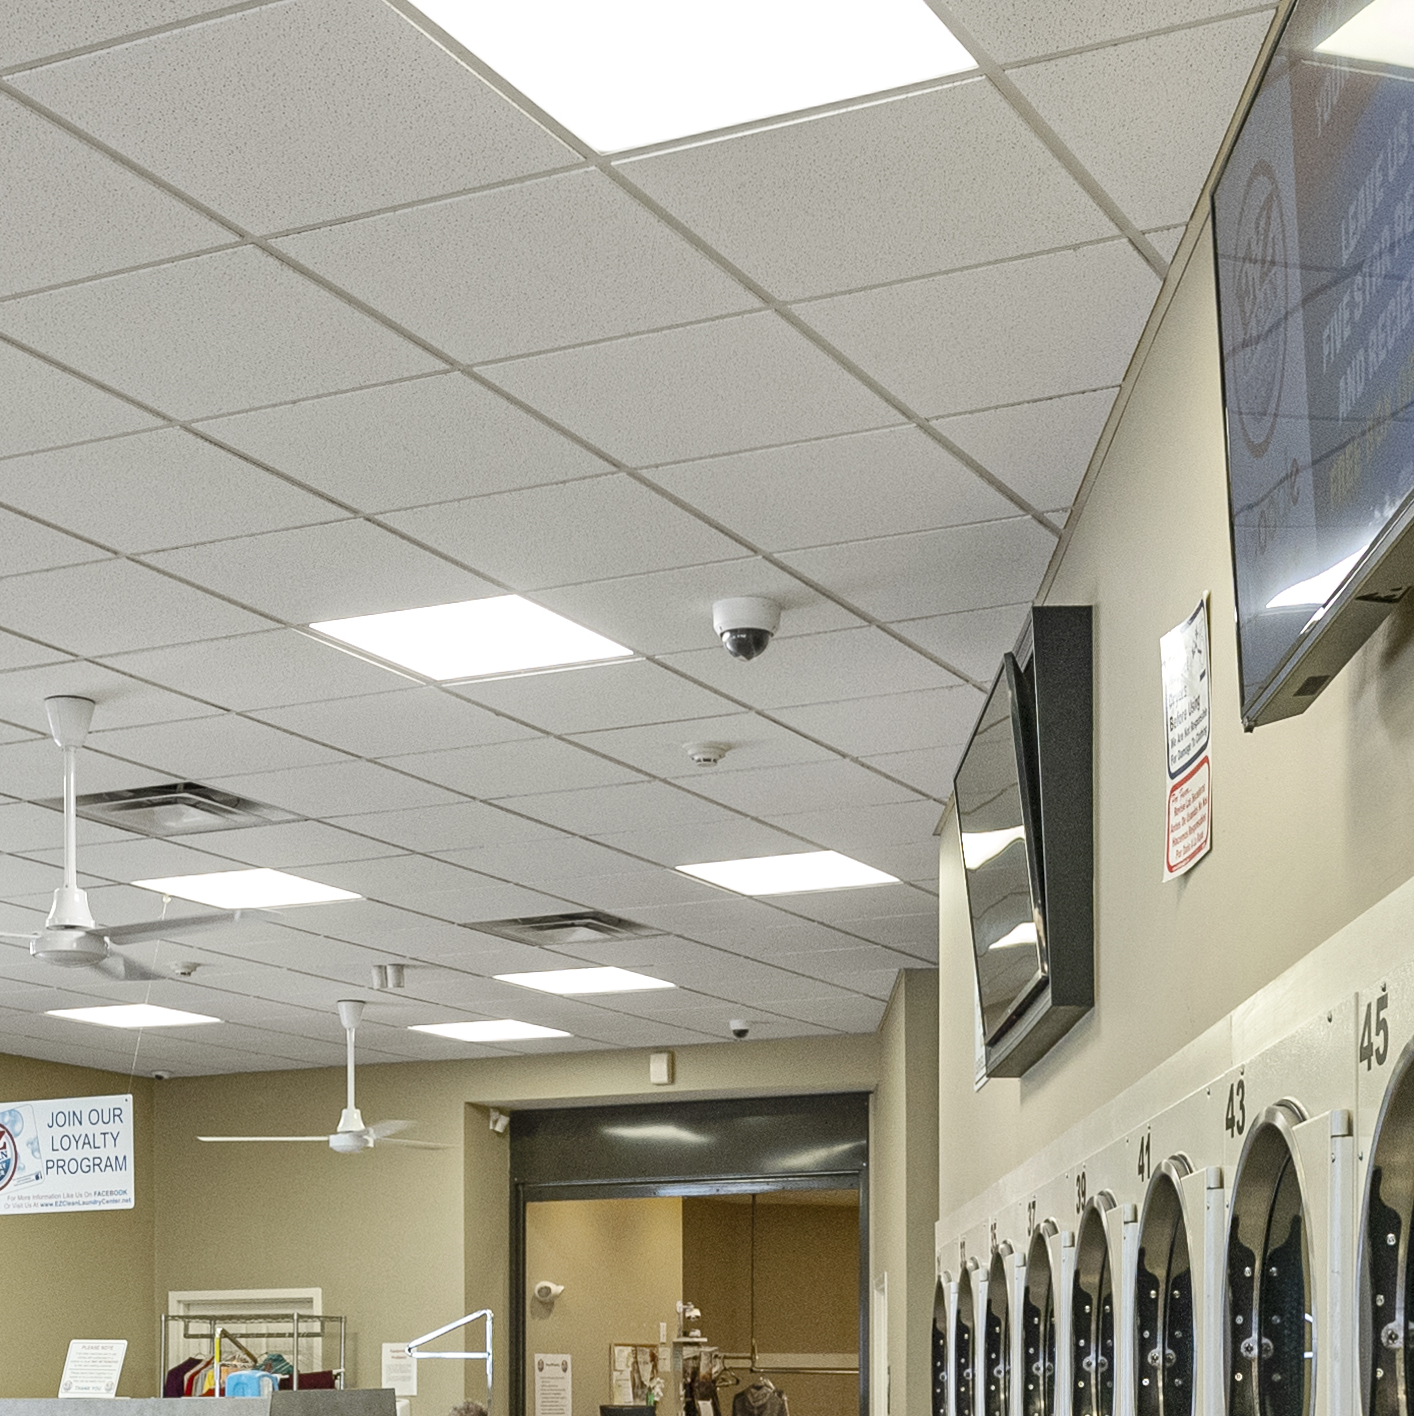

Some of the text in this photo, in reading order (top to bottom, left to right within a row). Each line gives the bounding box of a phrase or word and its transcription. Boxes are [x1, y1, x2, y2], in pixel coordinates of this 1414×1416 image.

[1359, 993, 1389, 1071] 45
[47, 1107, 123, 1128] JOIN OUR
[1225, 1079, 1246, 1139] 43
[51, 1131, 120, 1152] LOYALTY
[1137, 1132, 1151, 1182] 41
[45, 1155, 127, 1175] PROGRAM
[94, 1189, 128, 1197] FACEBOOK
[1076, 1171, 1087, 1215] 39
